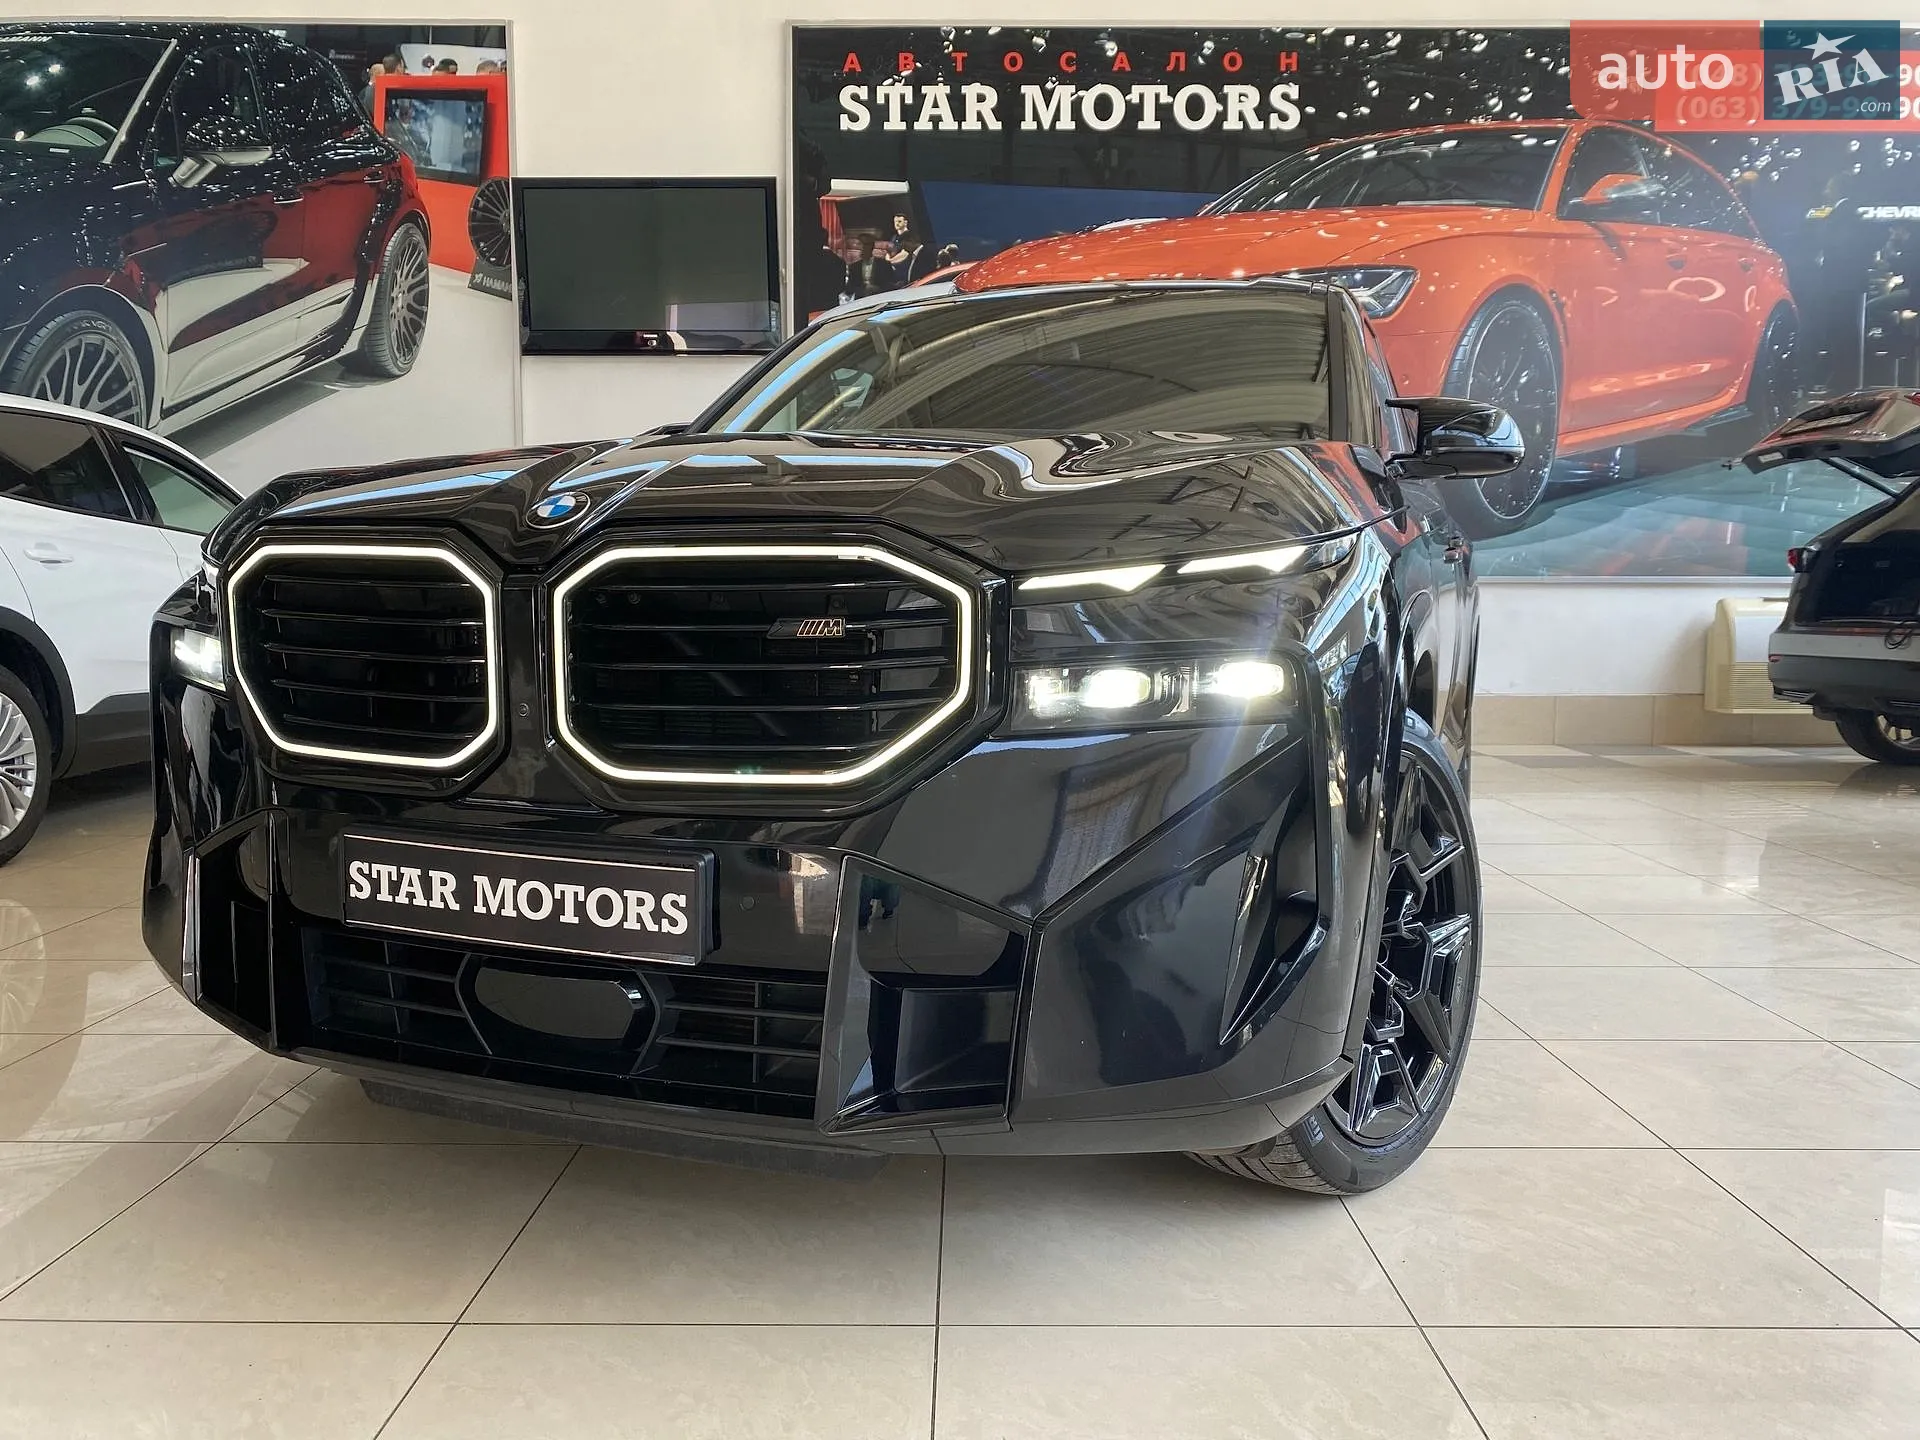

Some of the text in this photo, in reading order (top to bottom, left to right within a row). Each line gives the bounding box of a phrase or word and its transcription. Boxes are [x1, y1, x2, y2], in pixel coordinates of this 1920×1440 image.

[842, 51, 1300, 73] АВТОСАЛОН
[838, 83, 1302, 131] STAR MOTORS
[349, 860, 689, 936] STAR MOTORS
